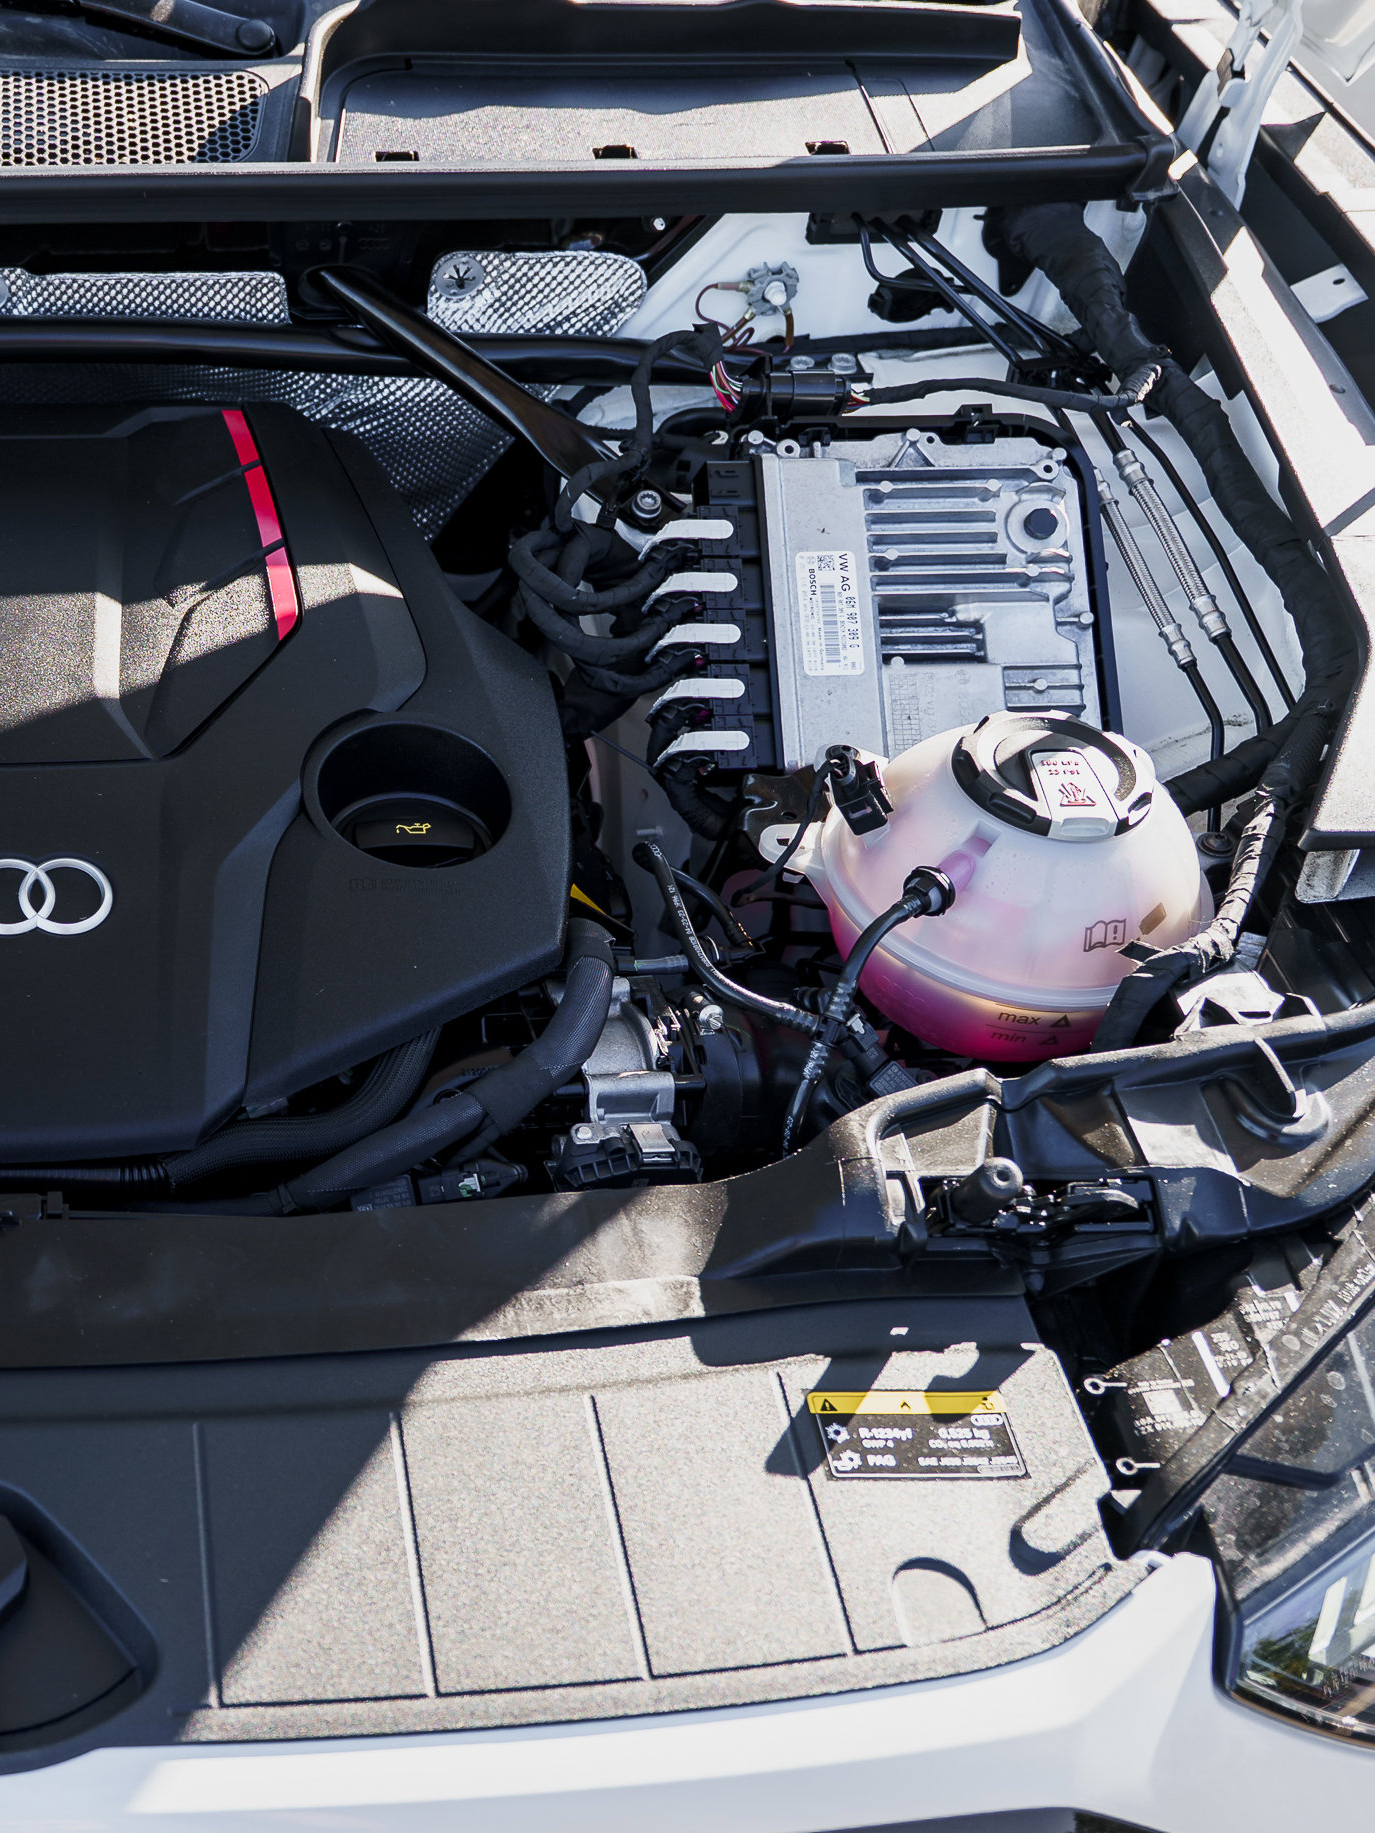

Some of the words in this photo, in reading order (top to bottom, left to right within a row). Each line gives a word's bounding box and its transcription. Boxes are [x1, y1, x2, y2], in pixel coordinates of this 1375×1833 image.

[838, 553, 848, 572] VW
[808, 568, 817, 596] BOSCH
[840, 575, 851, 592] AG
[997, 1012, 1042, 1026] max
[990, 1031, 1027, 1043] min
